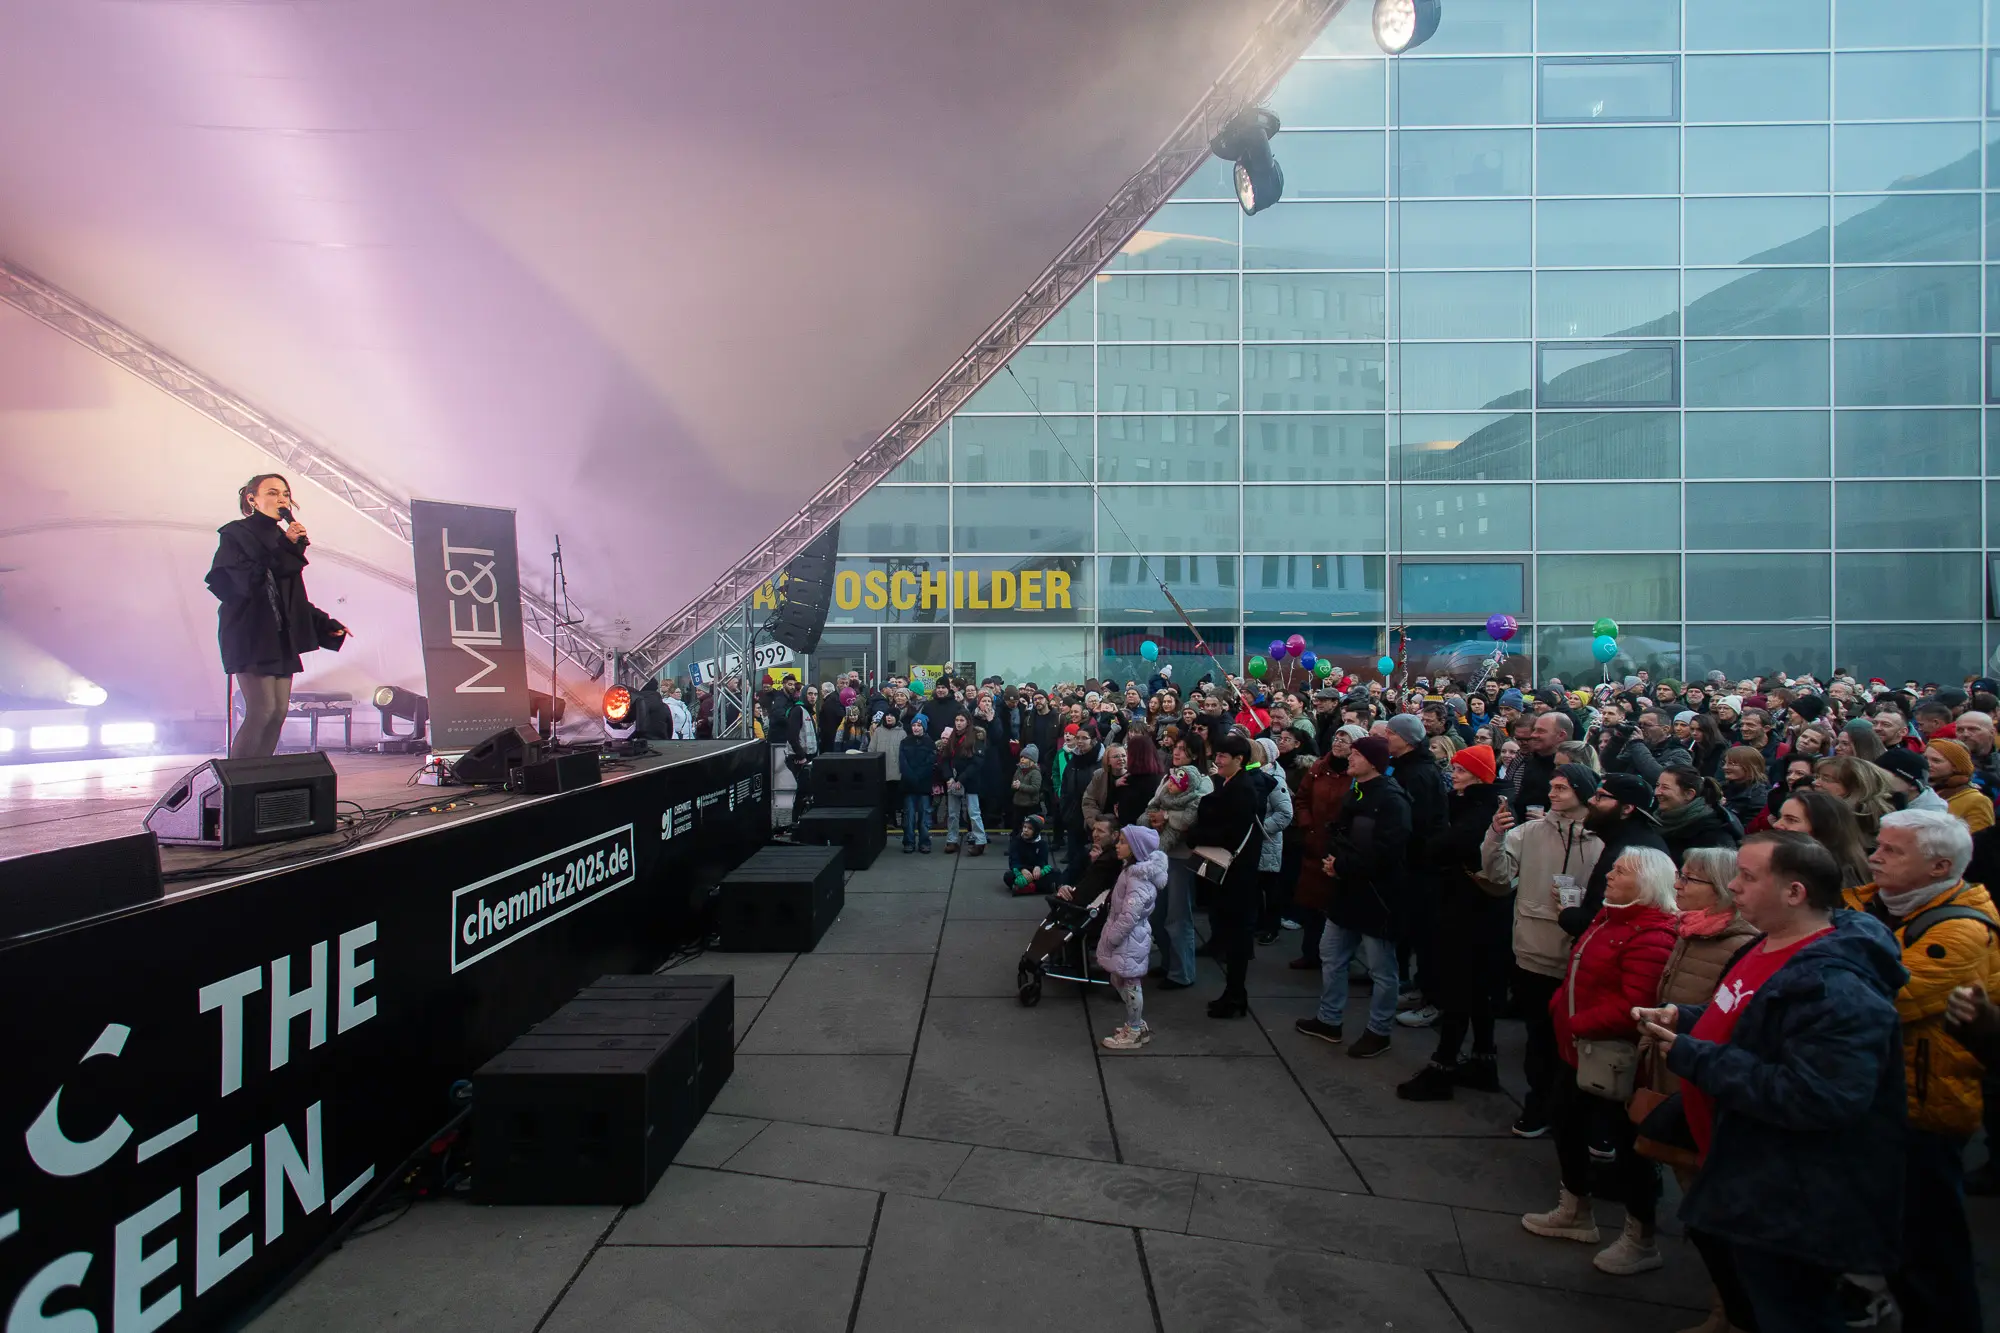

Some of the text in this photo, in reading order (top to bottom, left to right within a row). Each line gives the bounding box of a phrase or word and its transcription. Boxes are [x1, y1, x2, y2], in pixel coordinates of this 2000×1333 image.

[442, 528, 506, 693] ME&T
[753, 570, 1072, 610] AOSCHILDER
[462, 842, 629, 945] chemnitz2025.de
[199, 920, 377, 1098] THE
